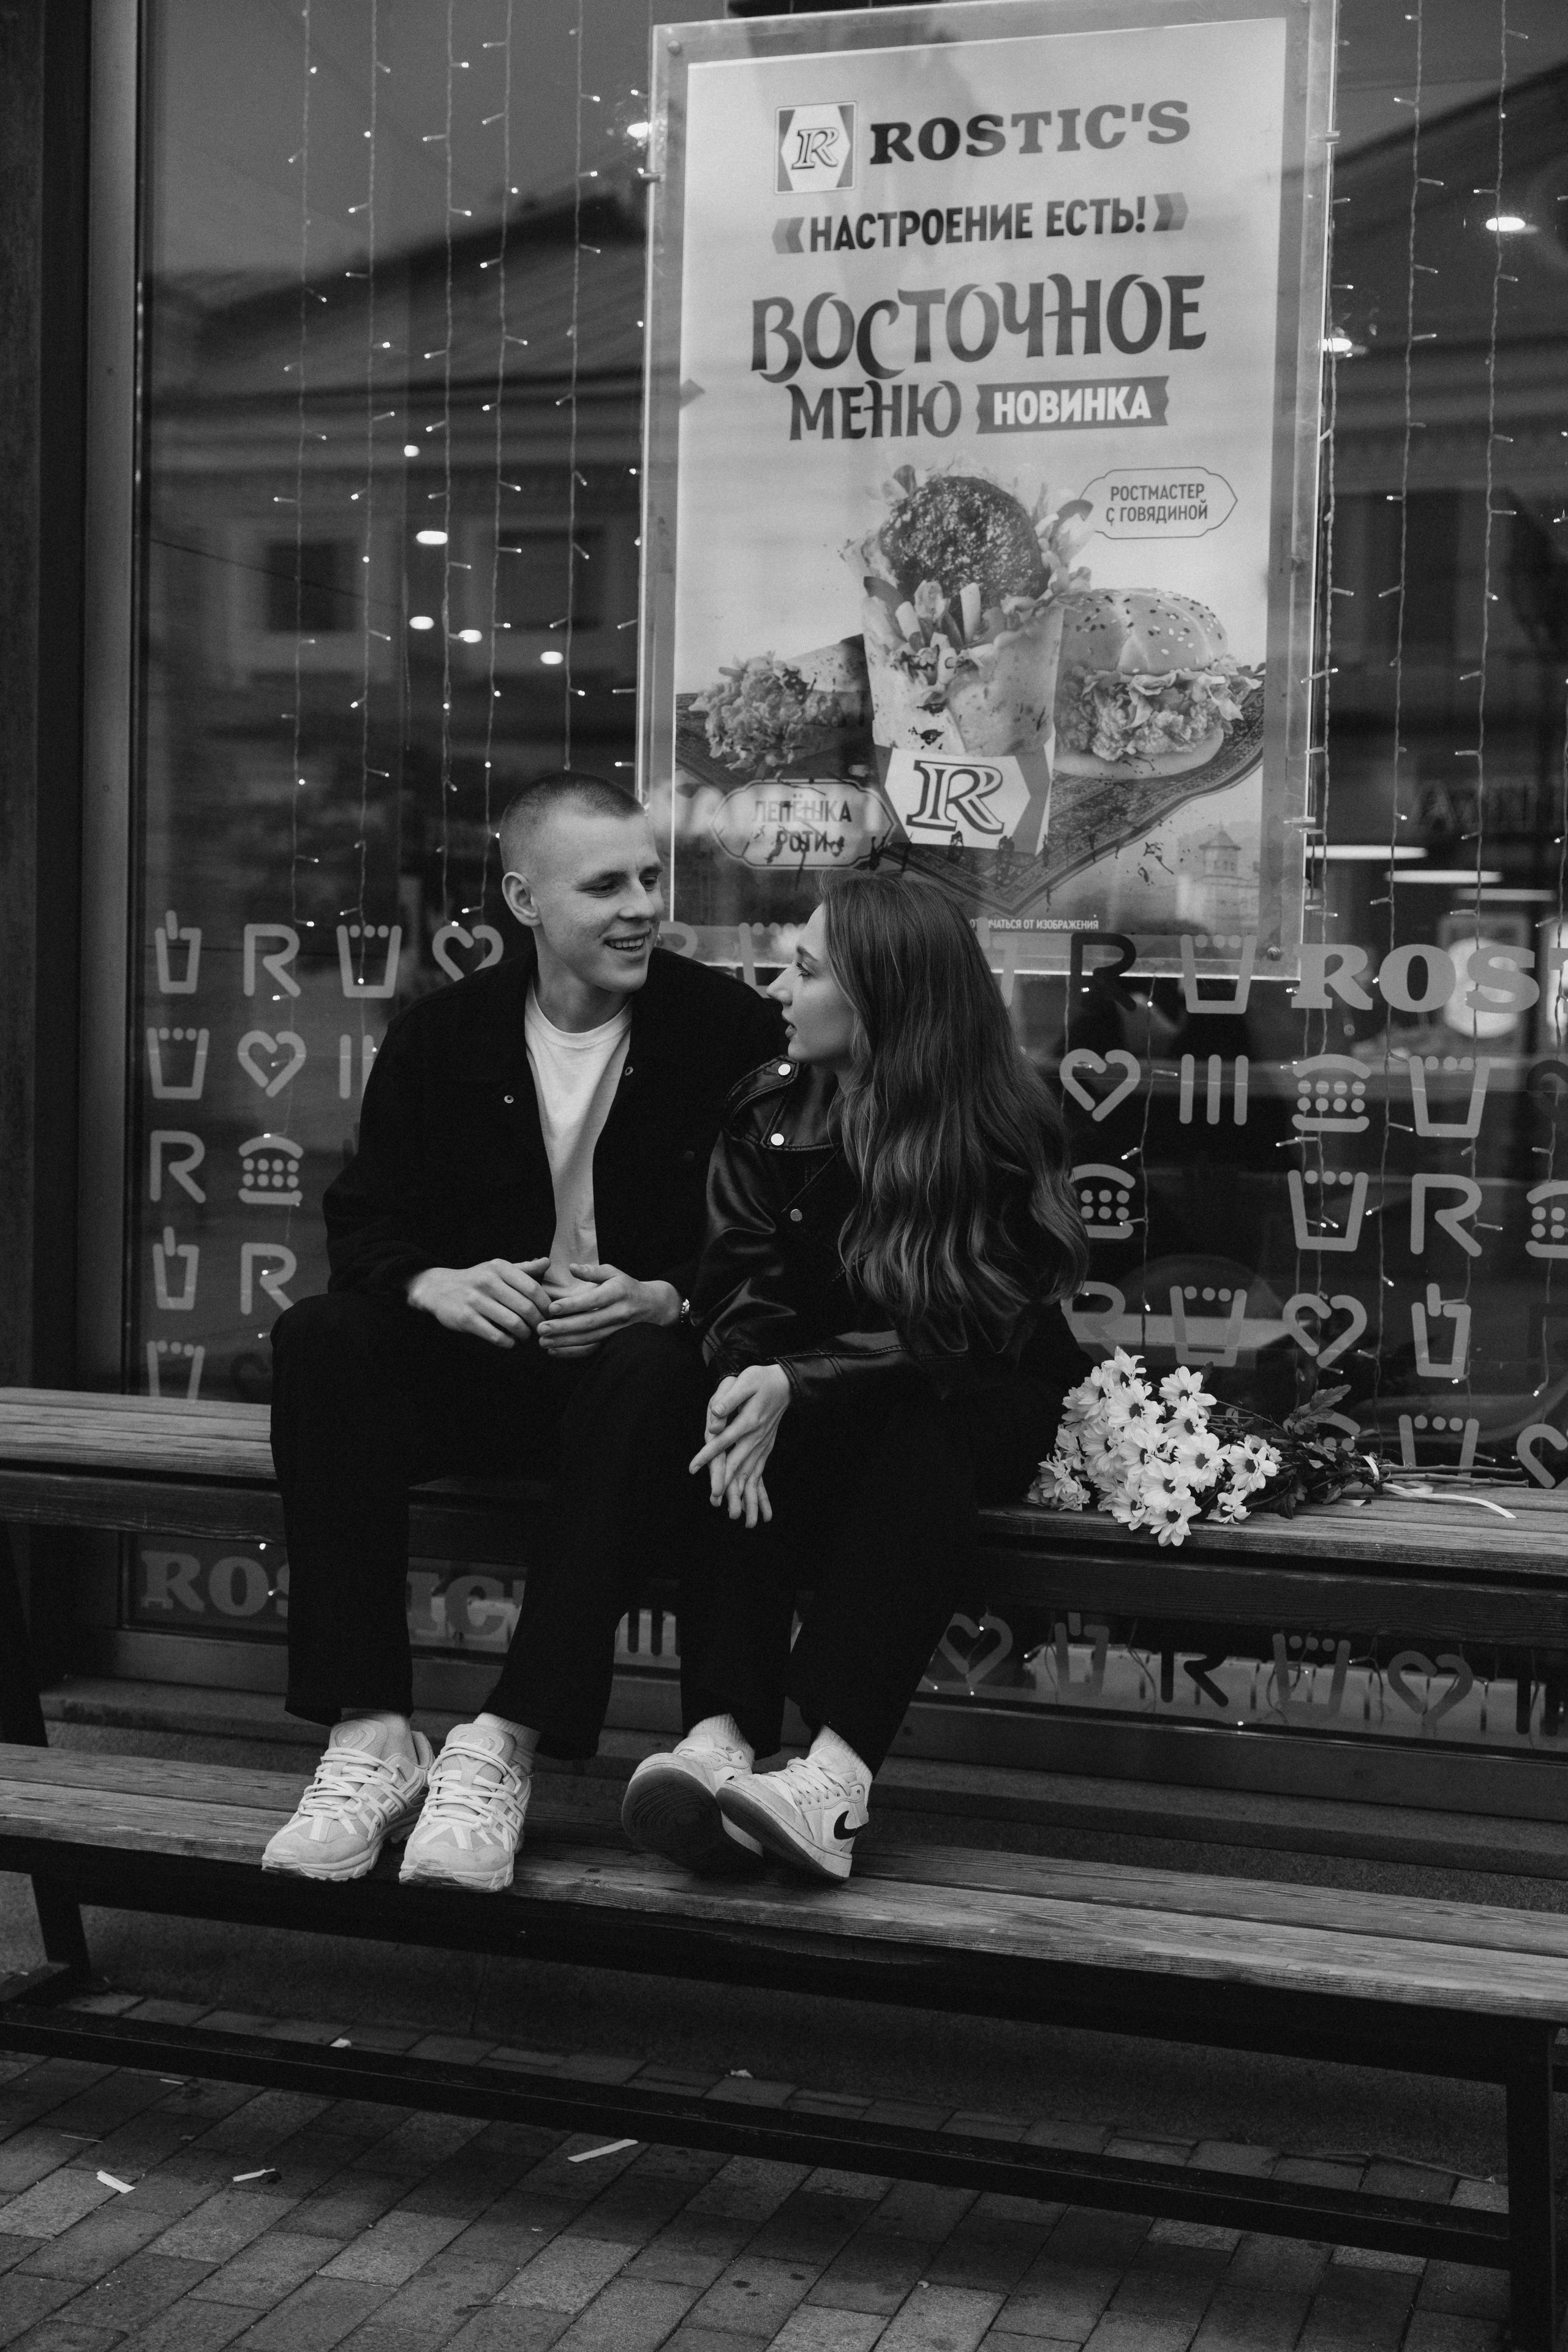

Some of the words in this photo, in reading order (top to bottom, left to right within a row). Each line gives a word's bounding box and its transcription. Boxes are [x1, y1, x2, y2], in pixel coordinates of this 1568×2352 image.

[870, 99, 1191, 165] ROSTIC'S
[809, 202, 1033, 253] НАСТРОЕНИЕ
[1045, 195, 1147, 238] ЕСТЬ!
[750, 273, 1207, 384] ВОСТОЧНОЕ
[785, 380, 962, 442] МЕНЮ
[992, 385, 1153, 427] НОВИНКА
[1110, 483, 1205, 501] РОСТМАСТЕР
[1119, 498, 1208, 524] ГОВЯДИНОЙ
[752, 793, 853, 823] ЛЕПЁШКА
[776, 830, 828, 853] РОТИ
[1023, 919, 1034, 930] ОТ
[1036, 919, 1099, 930] ИЗОБРАЖЕНИЯ
